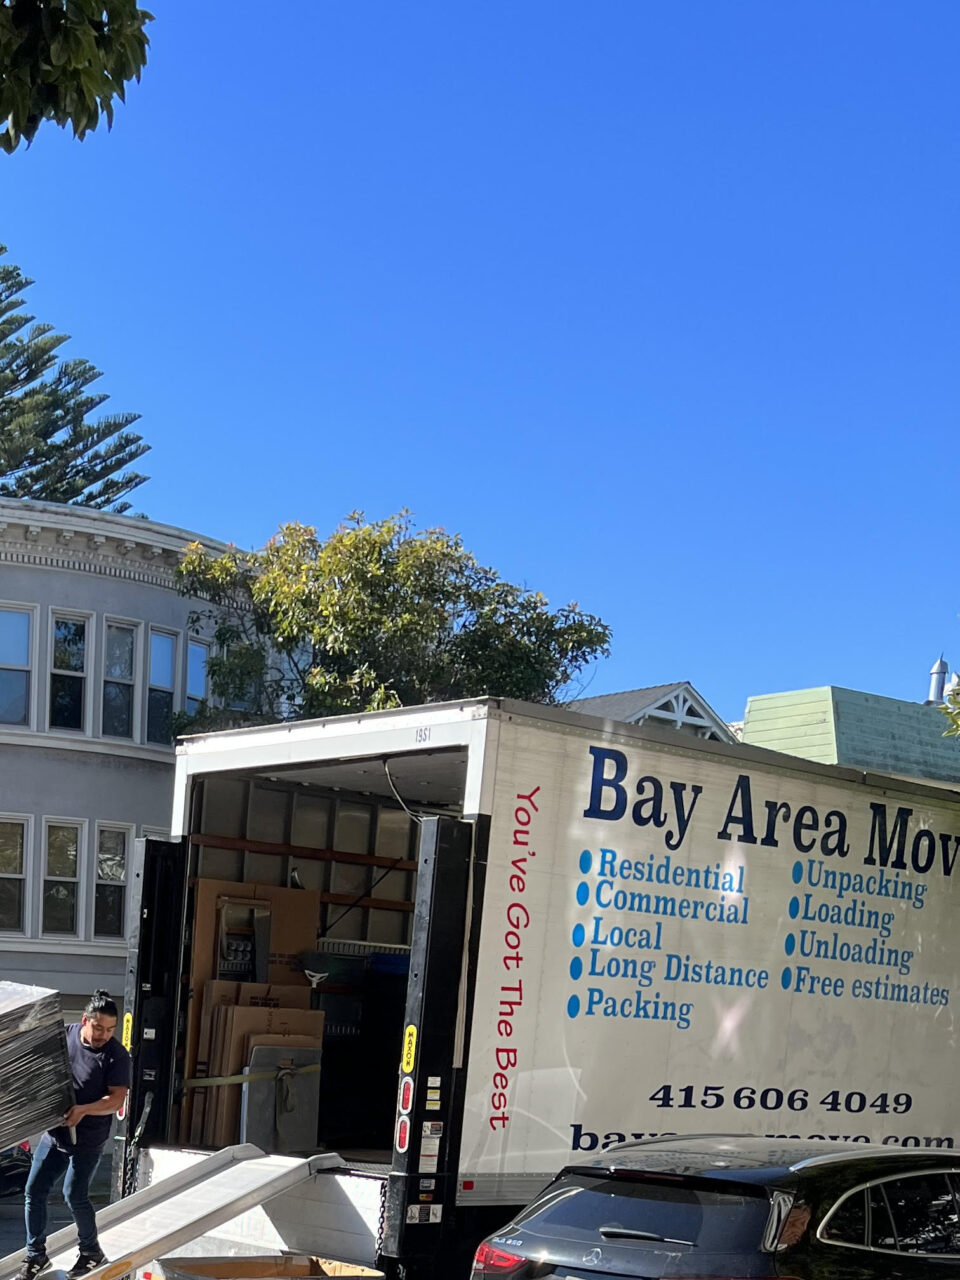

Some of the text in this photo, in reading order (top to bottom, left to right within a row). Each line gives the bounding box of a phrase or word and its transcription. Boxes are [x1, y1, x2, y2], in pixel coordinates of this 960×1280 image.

[583, 745, 703, 851] Bay
[717, 774, 850, 858] Area
[597, 848, 745, 894] Residential
[807, 859, 927, 909] Unpacking
[595, 879, 749, 924] Commercial
[802, 893, 895, 938] Loading
[591, 916, 663, 950] Local
[799, 929, 914, 976] Unloading
[489, 785, 540, 1131] You've Got The Best
[588, 948, 769, 989] Long Distance
[585, 987, 694, 1030] Packing
[793, 966, 950, 1007] Free estimates
[405, 1031, 414, 1067] MAXON
[648, 1084, 913, 1114] 415 606 4049
